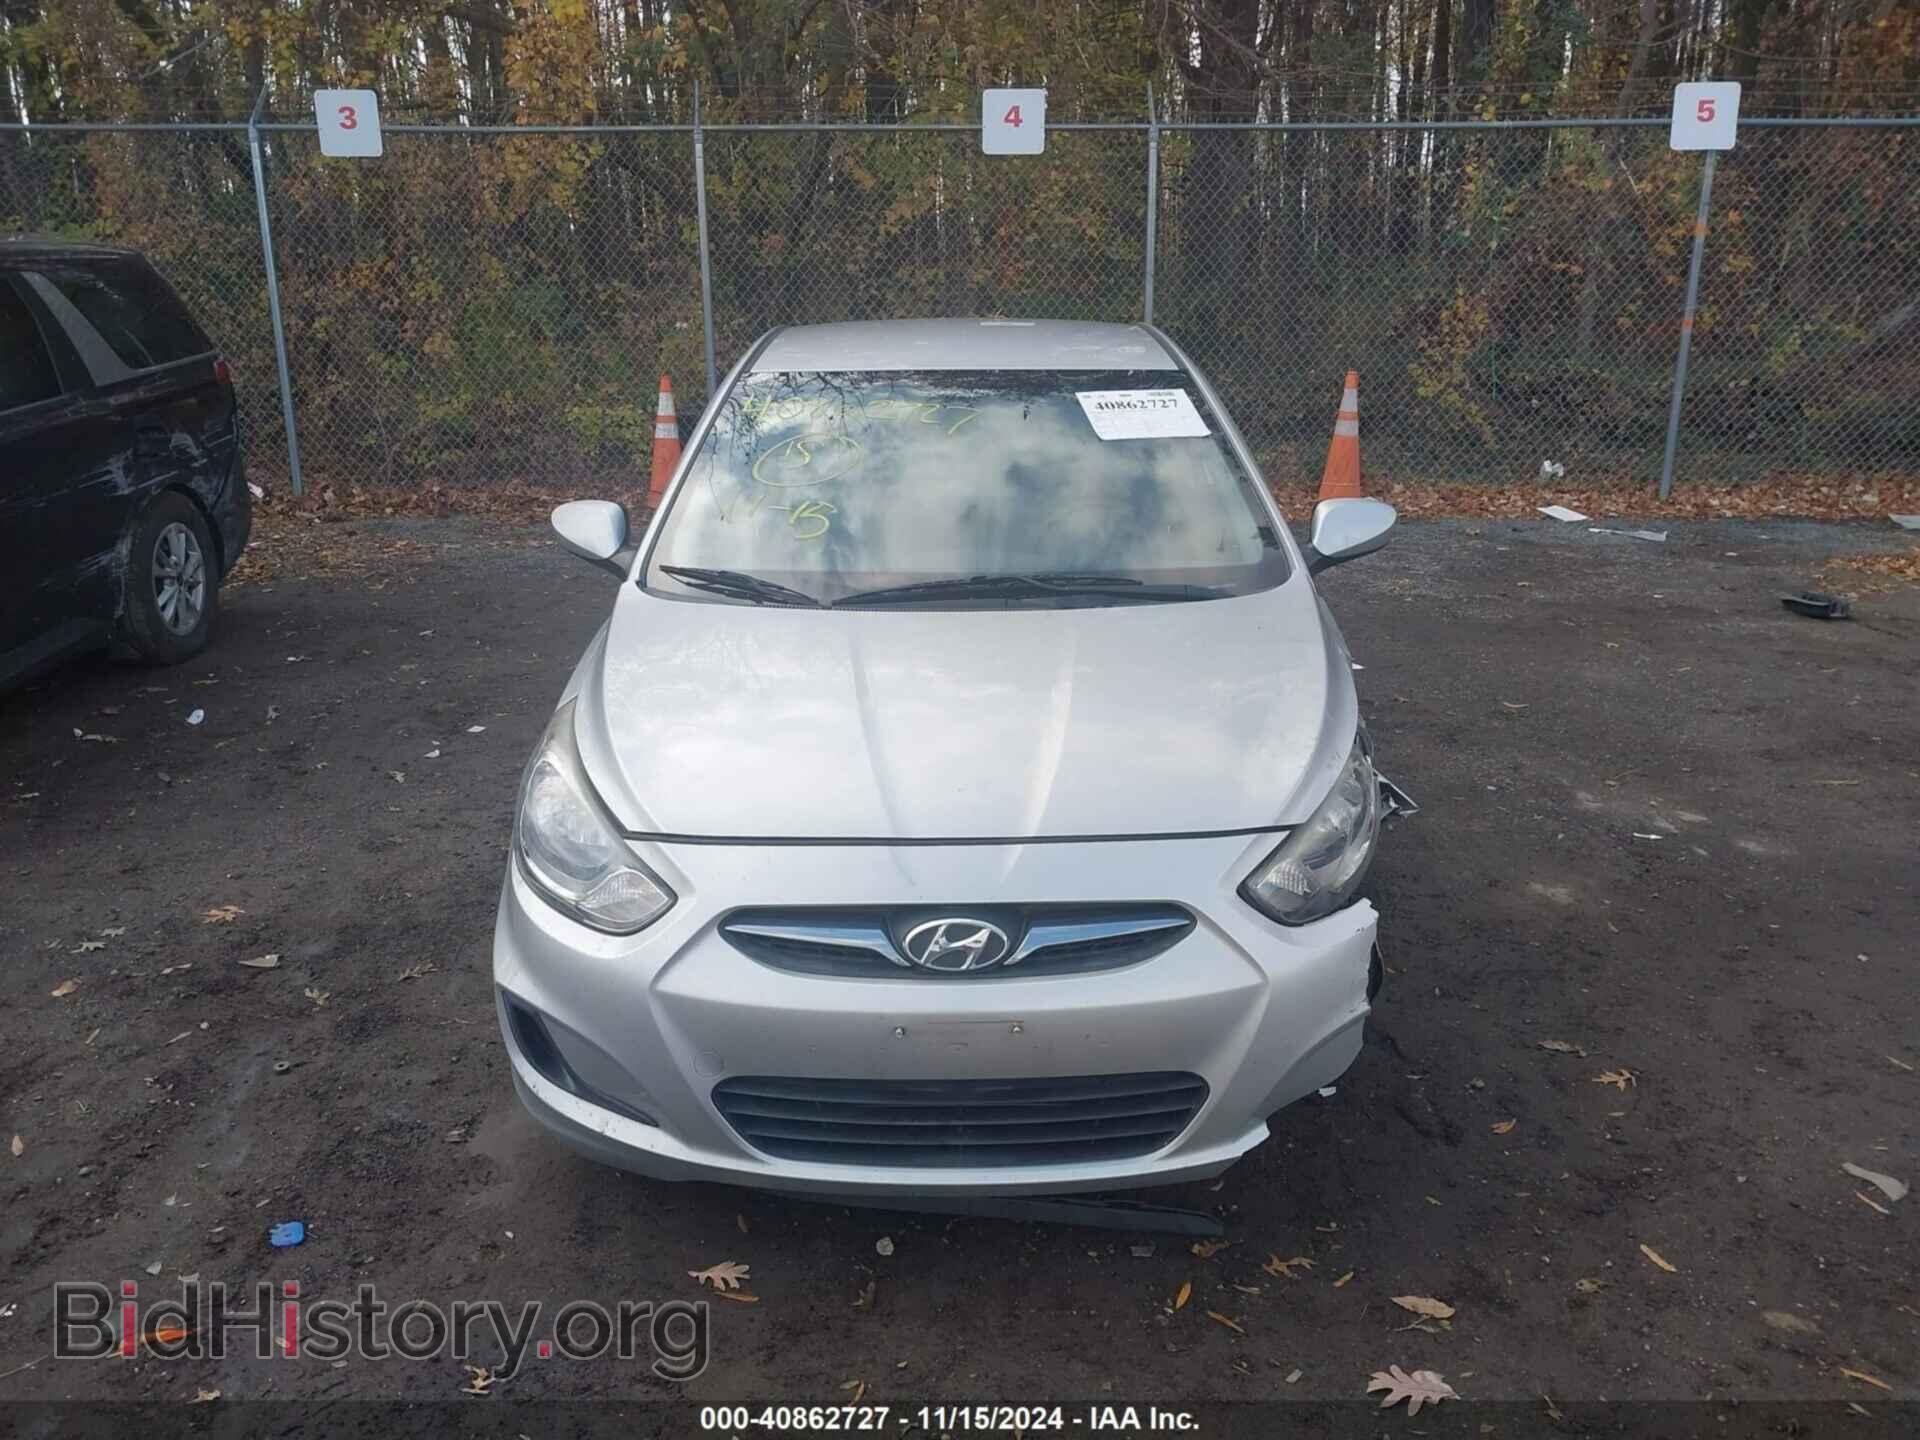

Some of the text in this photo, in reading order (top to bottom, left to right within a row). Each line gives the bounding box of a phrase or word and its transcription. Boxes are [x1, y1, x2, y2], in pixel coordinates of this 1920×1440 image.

[338, 106, 358, 129] 3
[1003, 105, 1024, 128] 4
[1696, 99, 1716, 122] 5
[1094, 398, 1178, 411] 40862727
